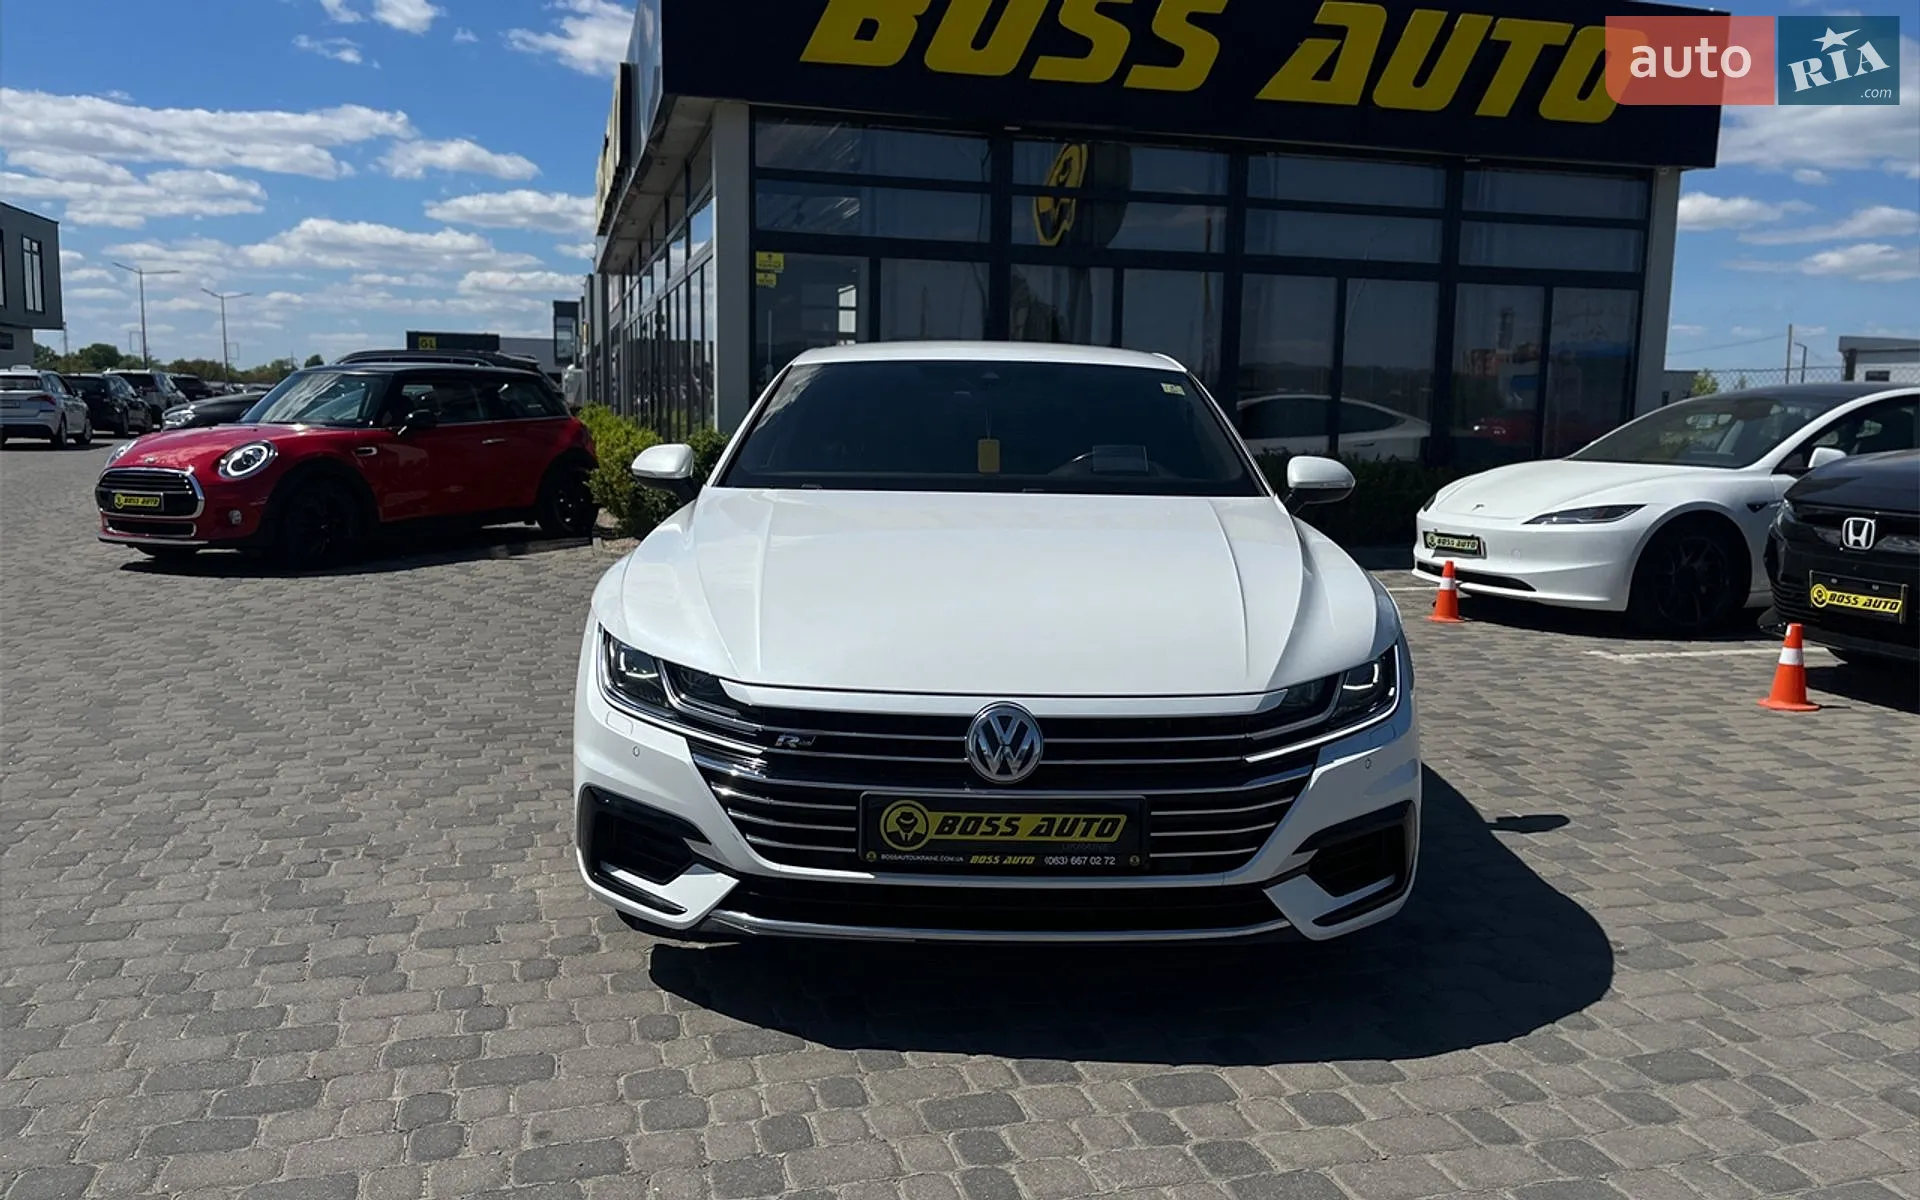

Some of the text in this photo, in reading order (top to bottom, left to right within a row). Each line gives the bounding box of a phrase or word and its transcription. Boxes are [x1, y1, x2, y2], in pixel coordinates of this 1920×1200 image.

[800, 0, 1649, 124] BOSS AUTO
[1437, 538, 1477, 548] BOSS AUTO
[1828, 592, 1899, 610] BOSS AUTO
[934, 814, 1123, 838] BOSS AUTO
[969, 855, 1000, 865] BOSS
[1002, 855, 1036, 865] AUTO
[1044, 855, 1069, 866] (063)
[1070, 855, 1088, 866] 667
[1089, 855, 1102, 866] 02
[1103, 856, 1117, 866] 72
